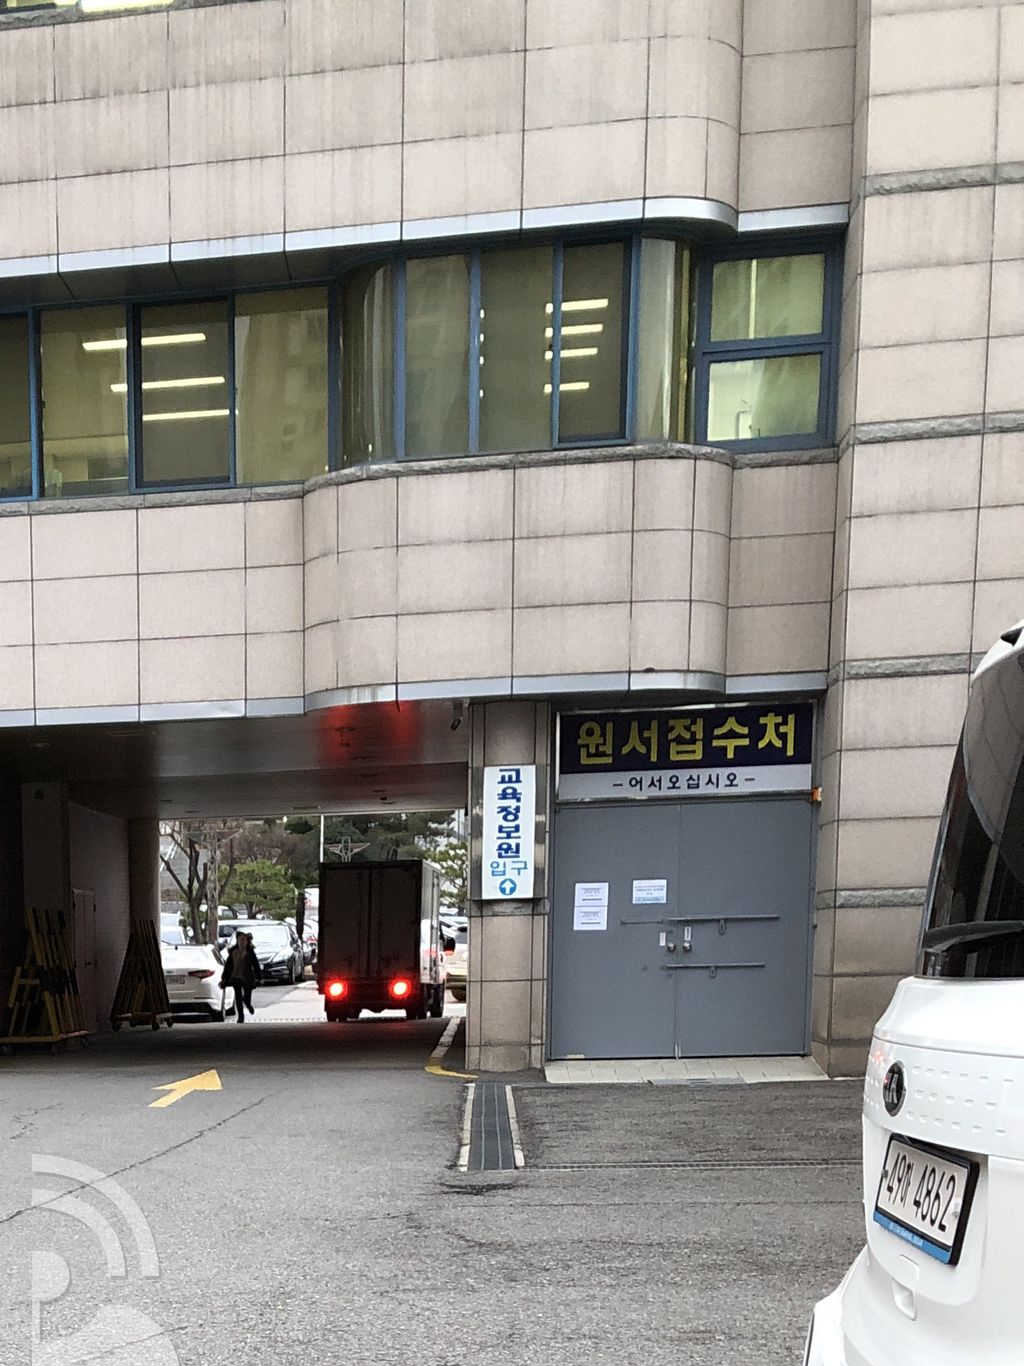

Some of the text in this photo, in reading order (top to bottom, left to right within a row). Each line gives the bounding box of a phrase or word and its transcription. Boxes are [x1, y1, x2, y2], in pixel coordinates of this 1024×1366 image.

[577, 712, 796, 764] 원서접수처
[496, 768, 522, 859] 교육정보원
[490, 860, 528, 877] 입구
[913, 1164, 956, 1233] 4862
